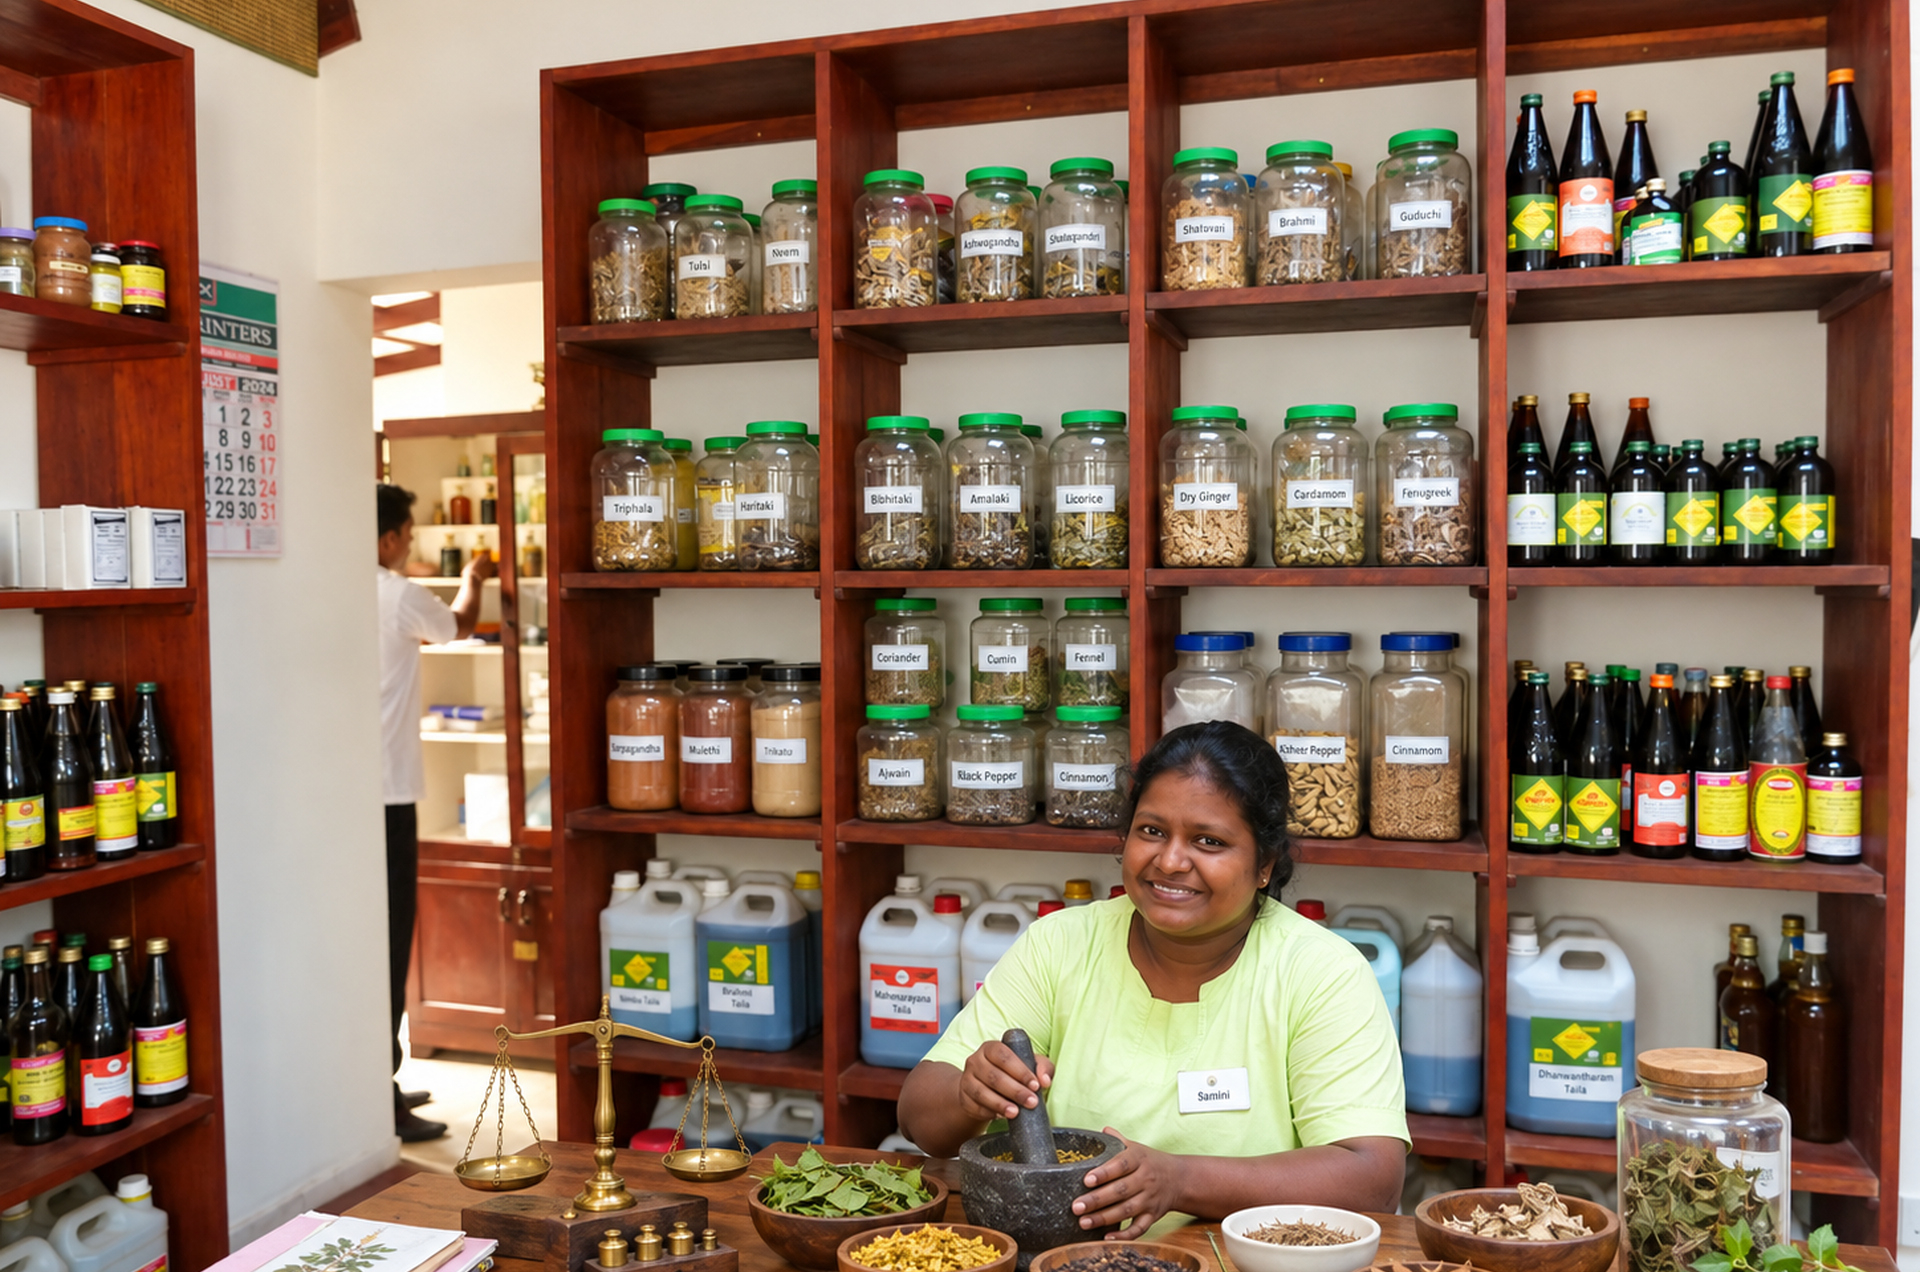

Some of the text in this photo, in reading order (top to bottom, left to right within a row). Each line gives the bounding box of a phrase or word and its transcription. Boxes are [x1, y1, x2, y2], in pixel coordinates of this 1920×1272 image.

[1279, 215, 1316, 229] Brahmi
[242, 378, 276, 396] 2024
[219, 405, 272, 429] 1 2 3
[218, 428, 276, 452] 8 9 10
[215, 452, 233, 472] 15
[238, 454, 256, 473] 16
[259, 456, 276, 476] 17
[215, 476, 234, 496] 22
[238, 478, 257, 497] 23
[259, 479, 277, 498] 24
[1065, 493, 1103, 505] Licorice
[1180, 490, 1231, 504] Dry Ginger
[215, 500, 235, 519] 29
[238, 501, 257, 520] 30
[260, 502, 276, 520] 31
[613, 503, 653, 516] Triphala
[876, 652, 921, 664] Coriander
[1563, 1083, 1588, 1095] Taila
